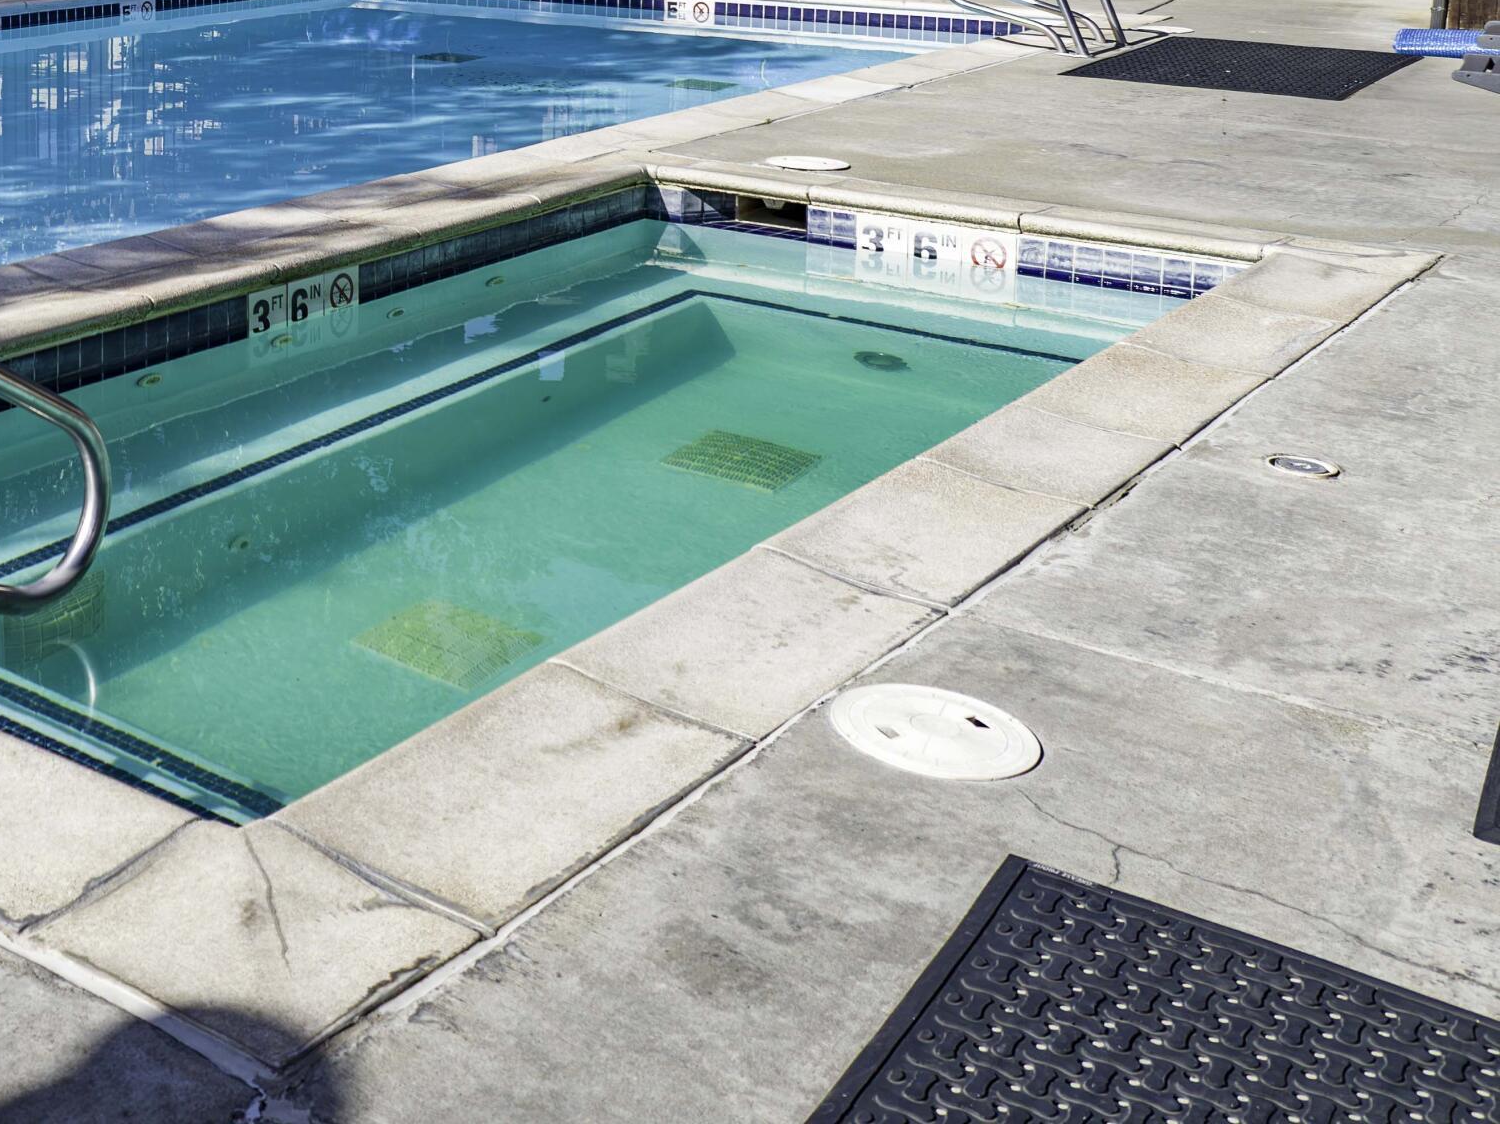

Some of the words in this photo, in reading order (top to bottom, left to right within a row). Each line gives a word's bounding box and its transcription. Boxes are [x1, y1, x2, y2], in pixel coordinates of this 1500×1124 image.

[862, 227, 884, 251] 3
[914, 231, 937, 259] 6
[941, 235, 957, 248] IN
[252, 299, 270, 333] 3
[272, 294, 283, 311] FT
[291, 288, 308, 322] 6
[310, 283, 321, 300] IN
